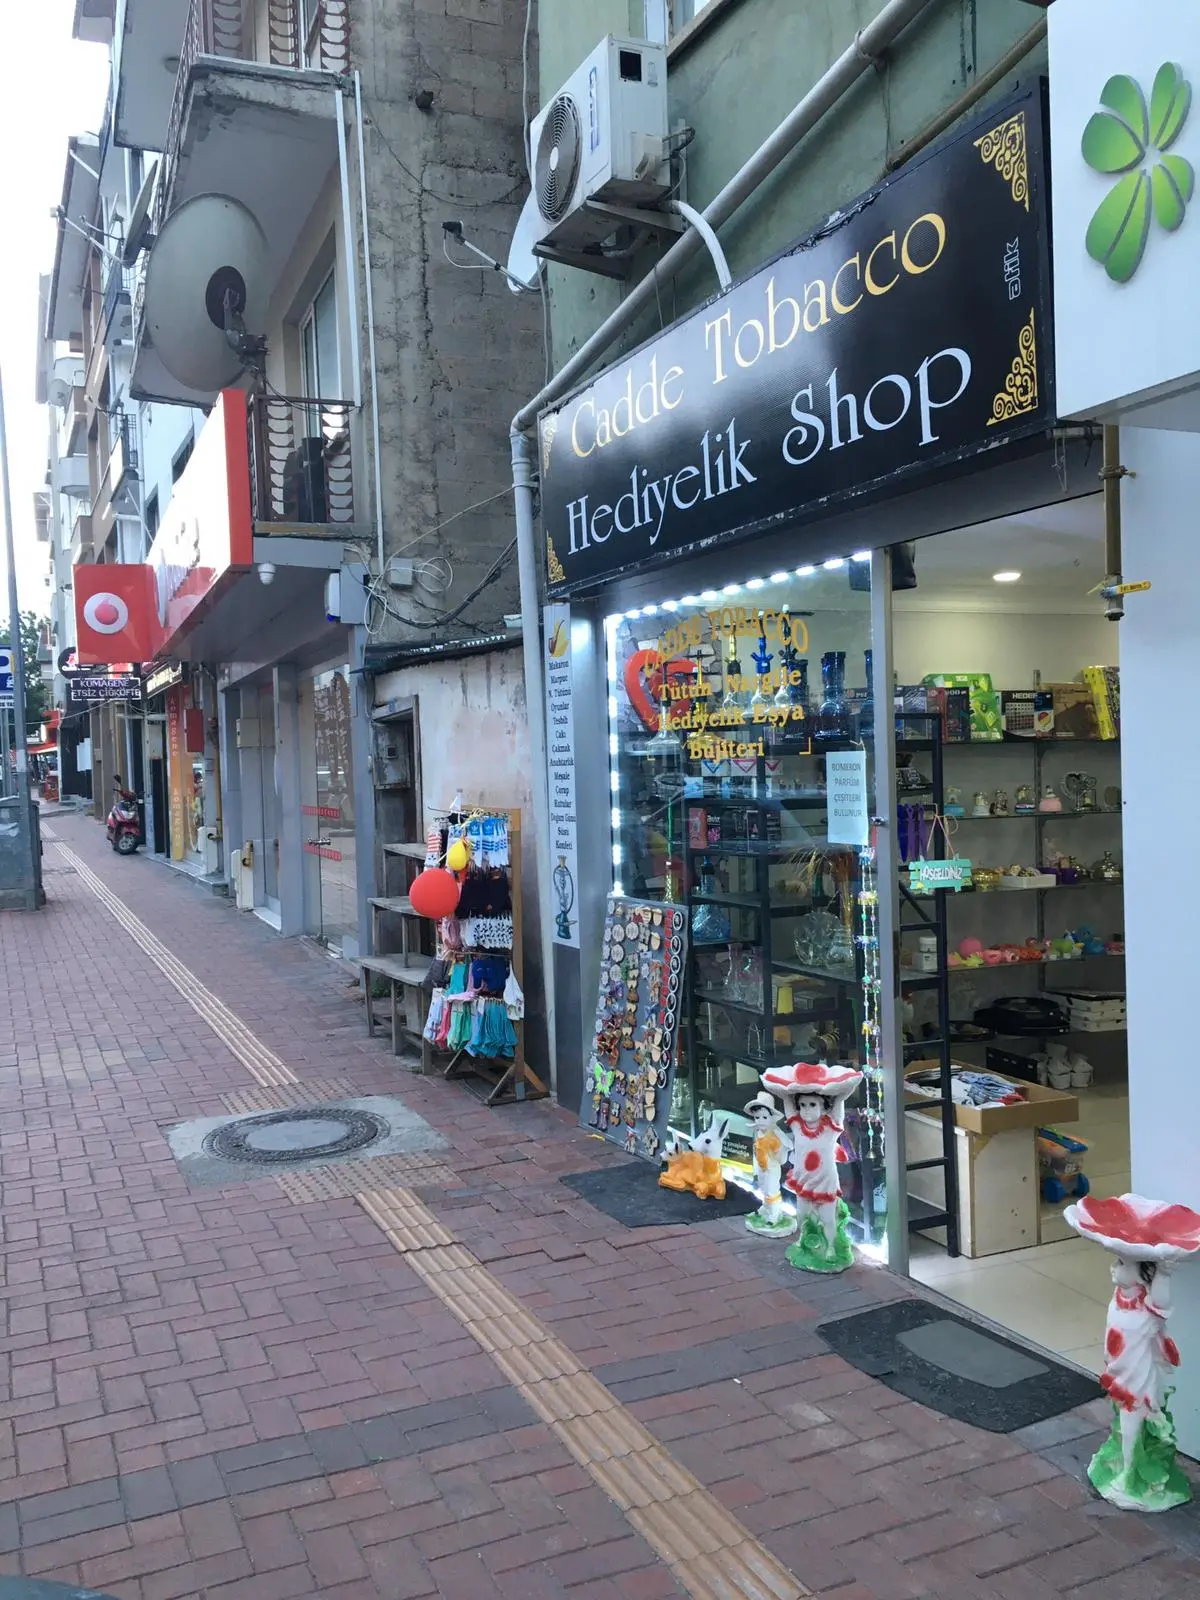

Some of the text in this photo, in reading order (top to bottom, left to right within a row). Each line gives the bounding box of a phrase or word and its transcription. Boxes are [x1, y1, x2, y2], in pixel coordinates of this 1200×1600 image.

[570, 211, 947, 459] Cadde Tobacco
[564, 346, 973, 556] Hediyelik Shop
[708, 608, 808, 653] TOBACCO
[656, 703, 806, 733] Hediyelik Eşya
